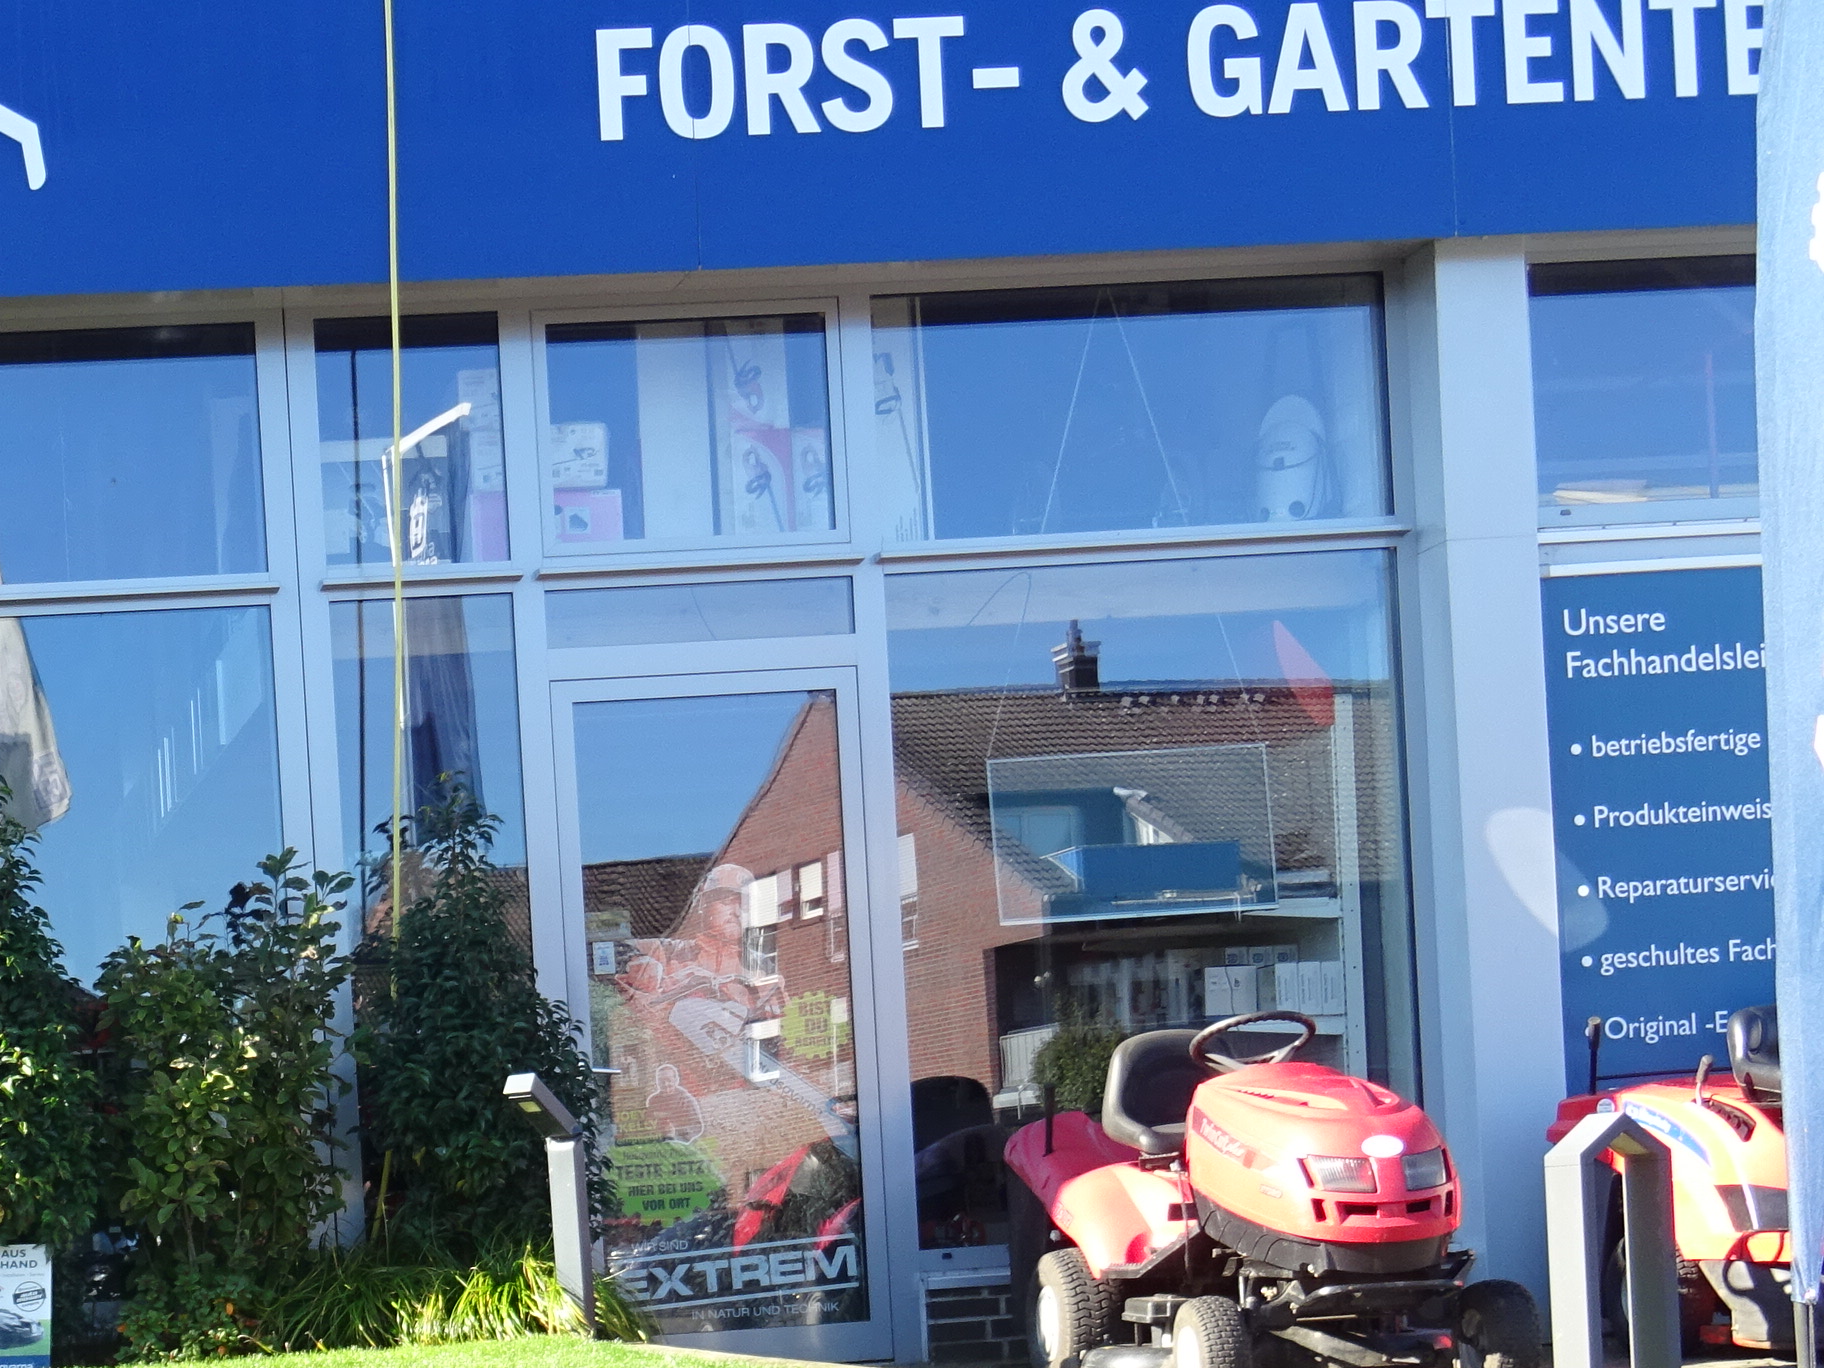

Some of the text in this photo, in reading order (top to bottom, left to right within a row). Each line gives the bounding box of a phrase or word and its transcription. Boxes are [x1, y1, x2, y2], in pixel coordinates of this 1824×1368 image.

[594, 15, 1020, 142] FORST-
[1062, 8, 1150, 124] &
[1563, 608, 1666, 636] Unsere
[1591, 728, 1761, 759] betriebsfertige
[1600, 942, 1719, 974] geschultes
[1604, 1012, 1697, 1044] Original
[628, 1181, 705, 1196] HIER BEI UNS
[642, 1197, 691, 1211] VOR ORT
[1, 1249, 27, 1258] AUS
[659, 1240, 689, 1251] SIND
[0, 1259, 38, 1270] HAND
[619, 1245, 859, 1301] EXTREM
[692, 1301, 840, 1321] IN NATUR UND TECHNIK
